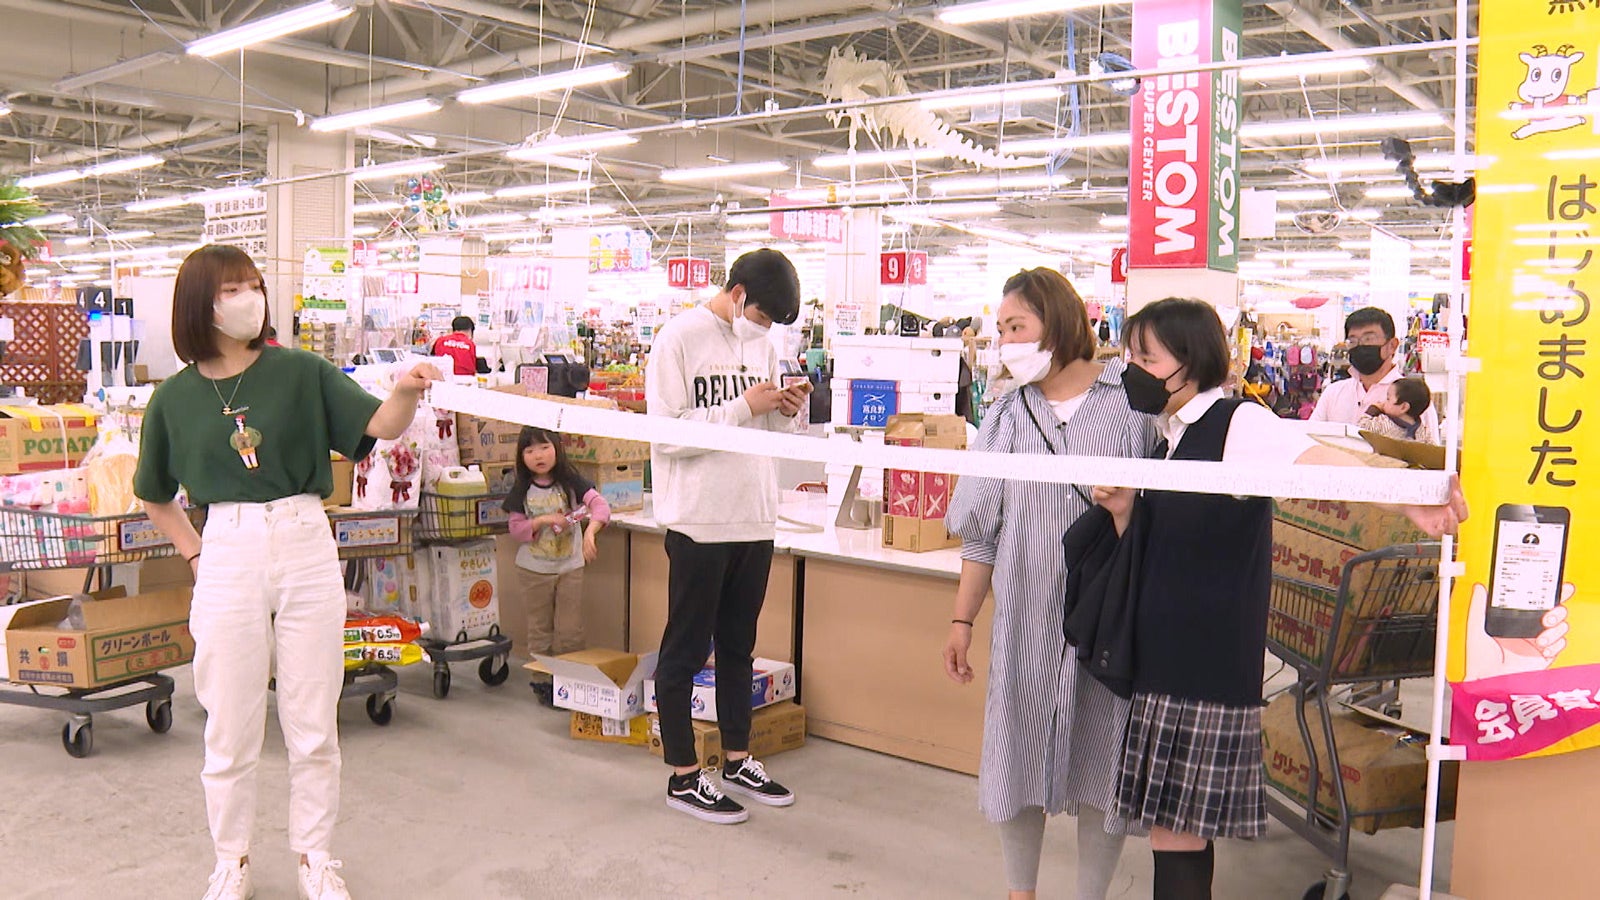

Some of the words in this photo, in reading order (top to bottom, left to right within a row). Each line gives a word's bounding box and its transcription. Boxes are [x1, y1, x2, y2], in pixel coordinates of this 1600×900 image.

[1143, 79, 1155, 134] SUPER
[1154, 20, 1199, 256] BESTOM
[1218, 27, 1238, 257] BESTOM
[1142, 137, 1154, 202] CENTER
[671, 263, 685, 283] 10
[887, 257, 899, 280] 9
[94, 291, 106, 308] 4
[121, 301, 127, 314] 1
[862, 414, 885, 422] メロン
[101, 630, 171, 655] グリーンボール
[19, 648, 31, 665] 共
